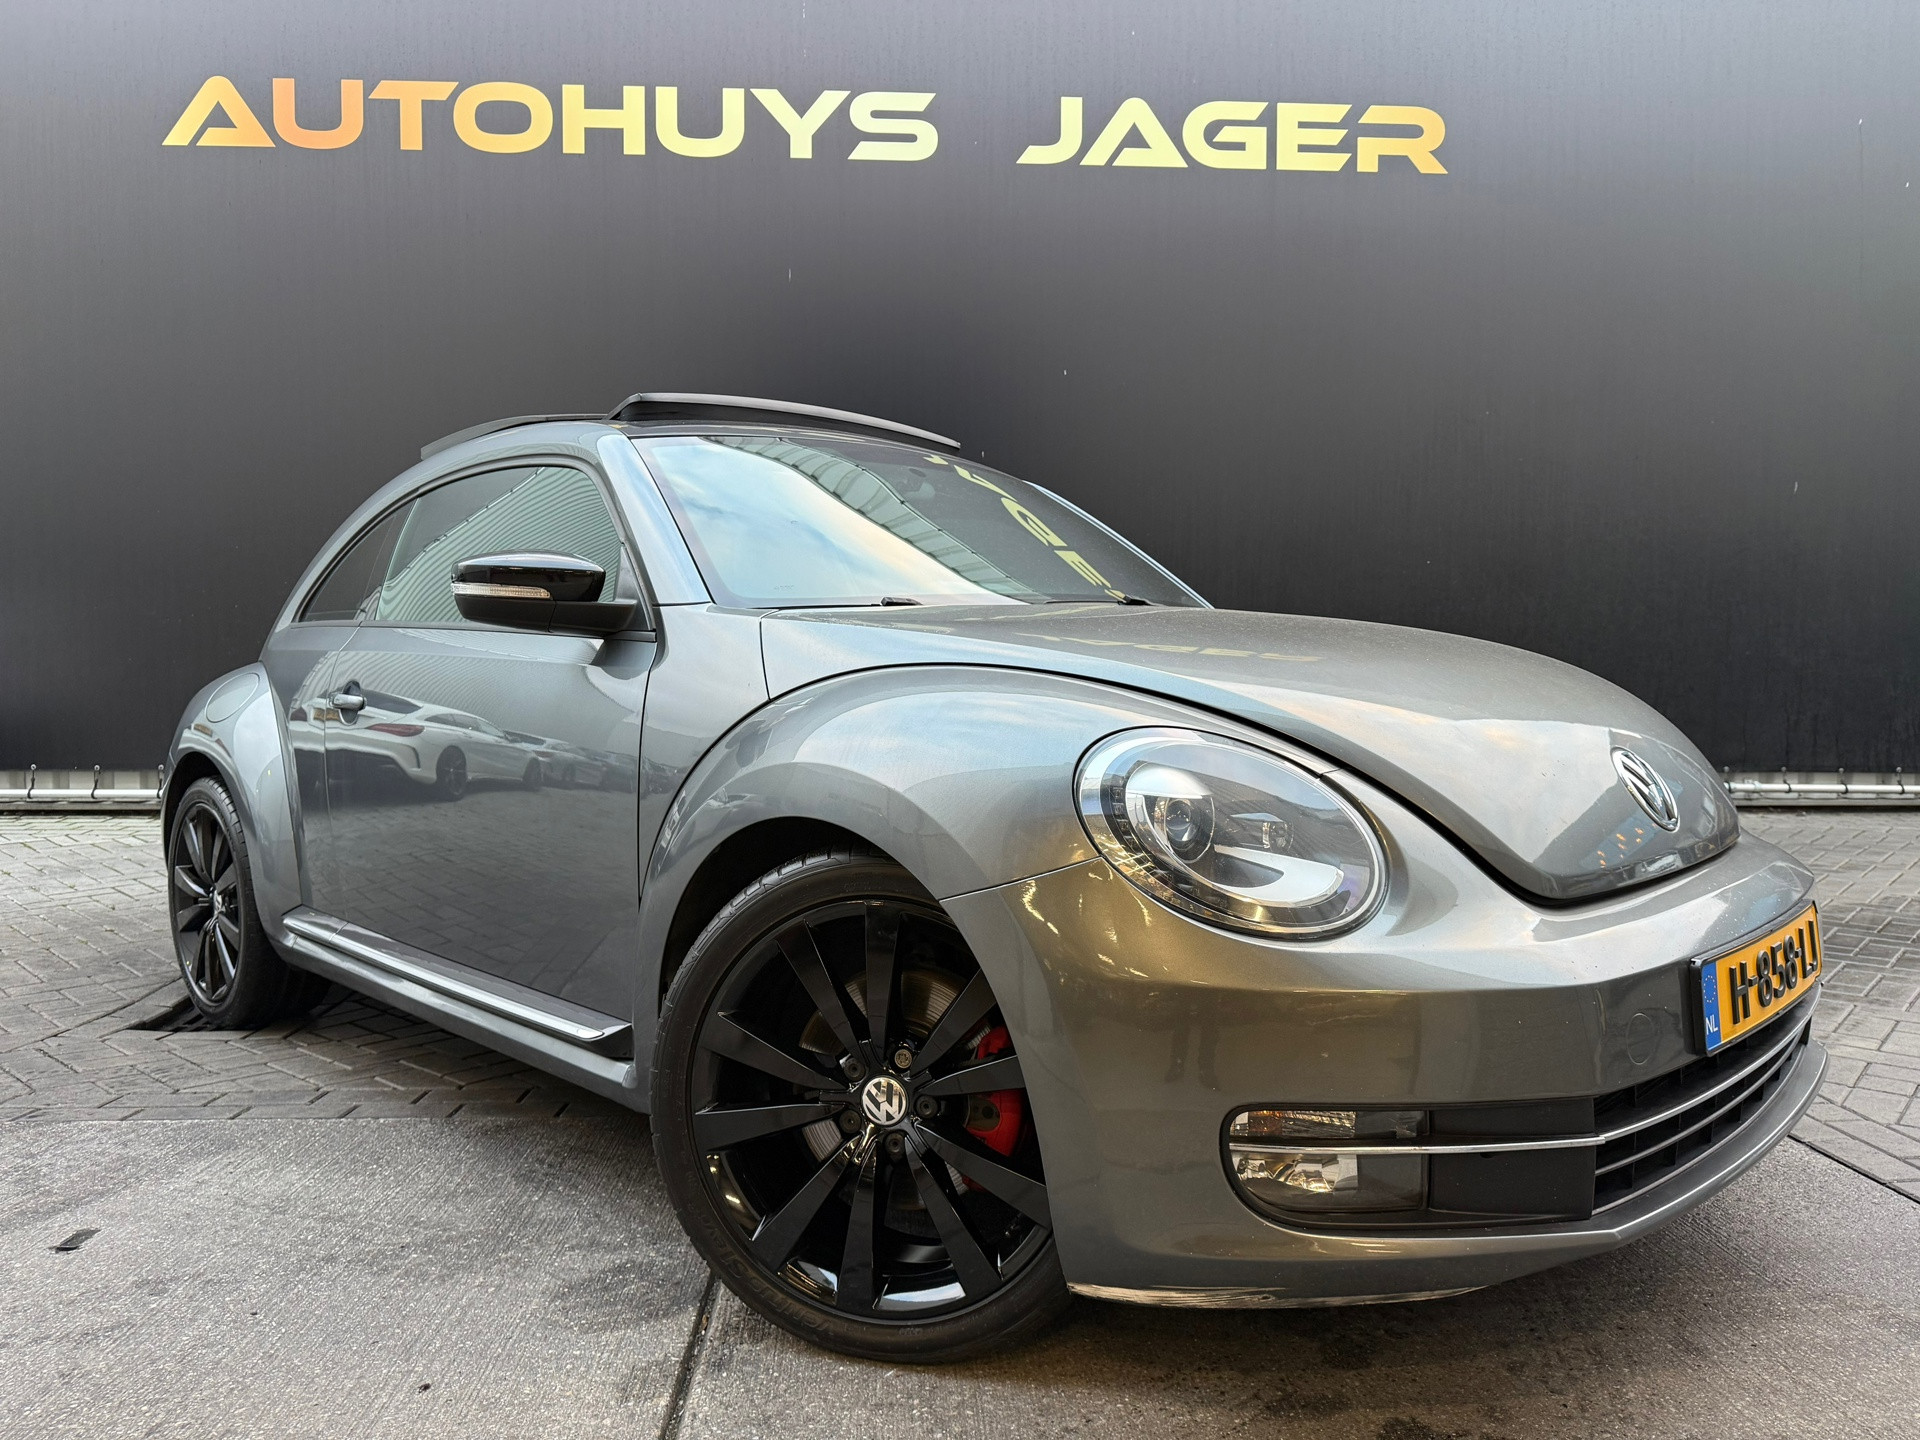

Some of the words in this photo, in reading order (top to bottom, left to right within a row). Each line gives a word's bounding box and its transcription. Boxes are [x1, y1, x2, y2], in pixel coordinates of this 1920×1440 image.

[162, 75, 940, 162] AUTOHUYS
[1016, 95, 1449, 175] JAGER
[1729, 920, 1818, 1025] H-858-LJ
[1705, 1014, 1719, 1035] NL
[862, 1077, 906, 1126] VW
